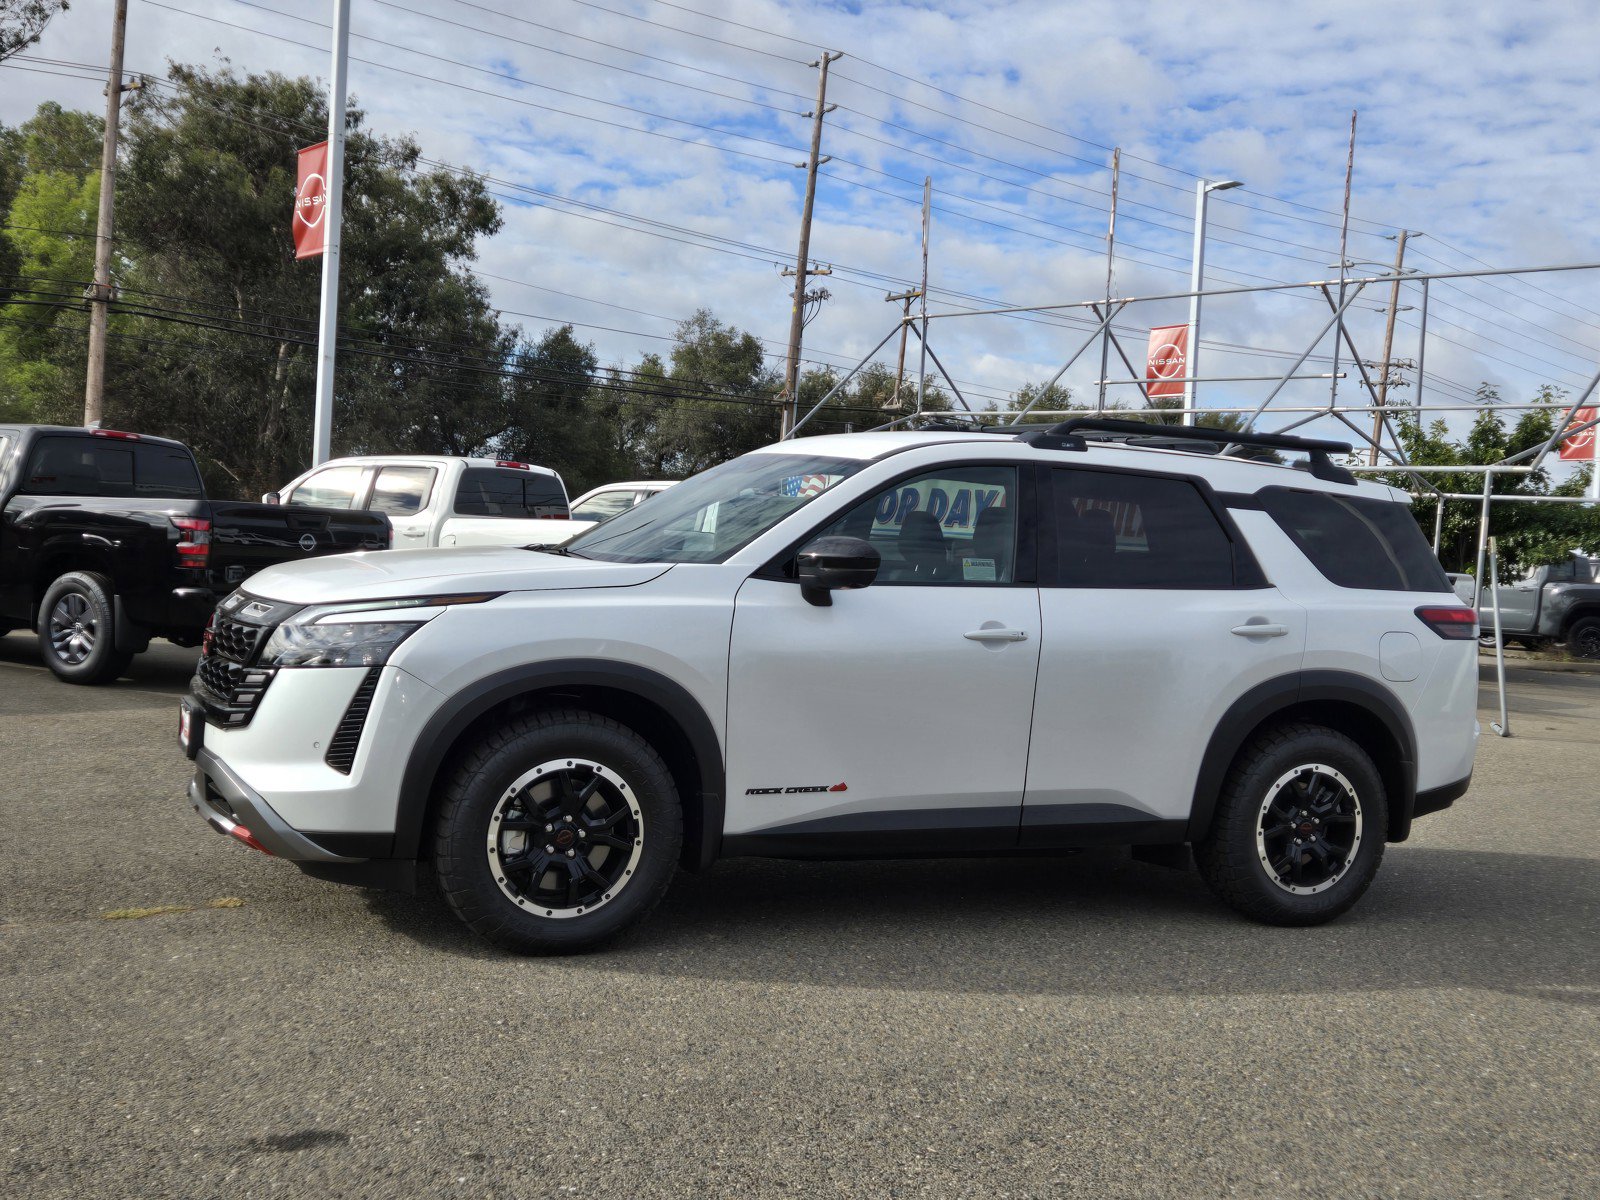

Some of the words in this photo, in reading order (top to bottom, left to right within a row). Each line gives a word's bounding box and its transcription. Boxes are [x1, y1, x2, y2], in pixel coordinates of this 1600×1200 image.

[296, 193, 327, 208] NISSAN
[1148, 357, 1186, 366] NISSAN
[926, 488, 1000, 528] DAY
